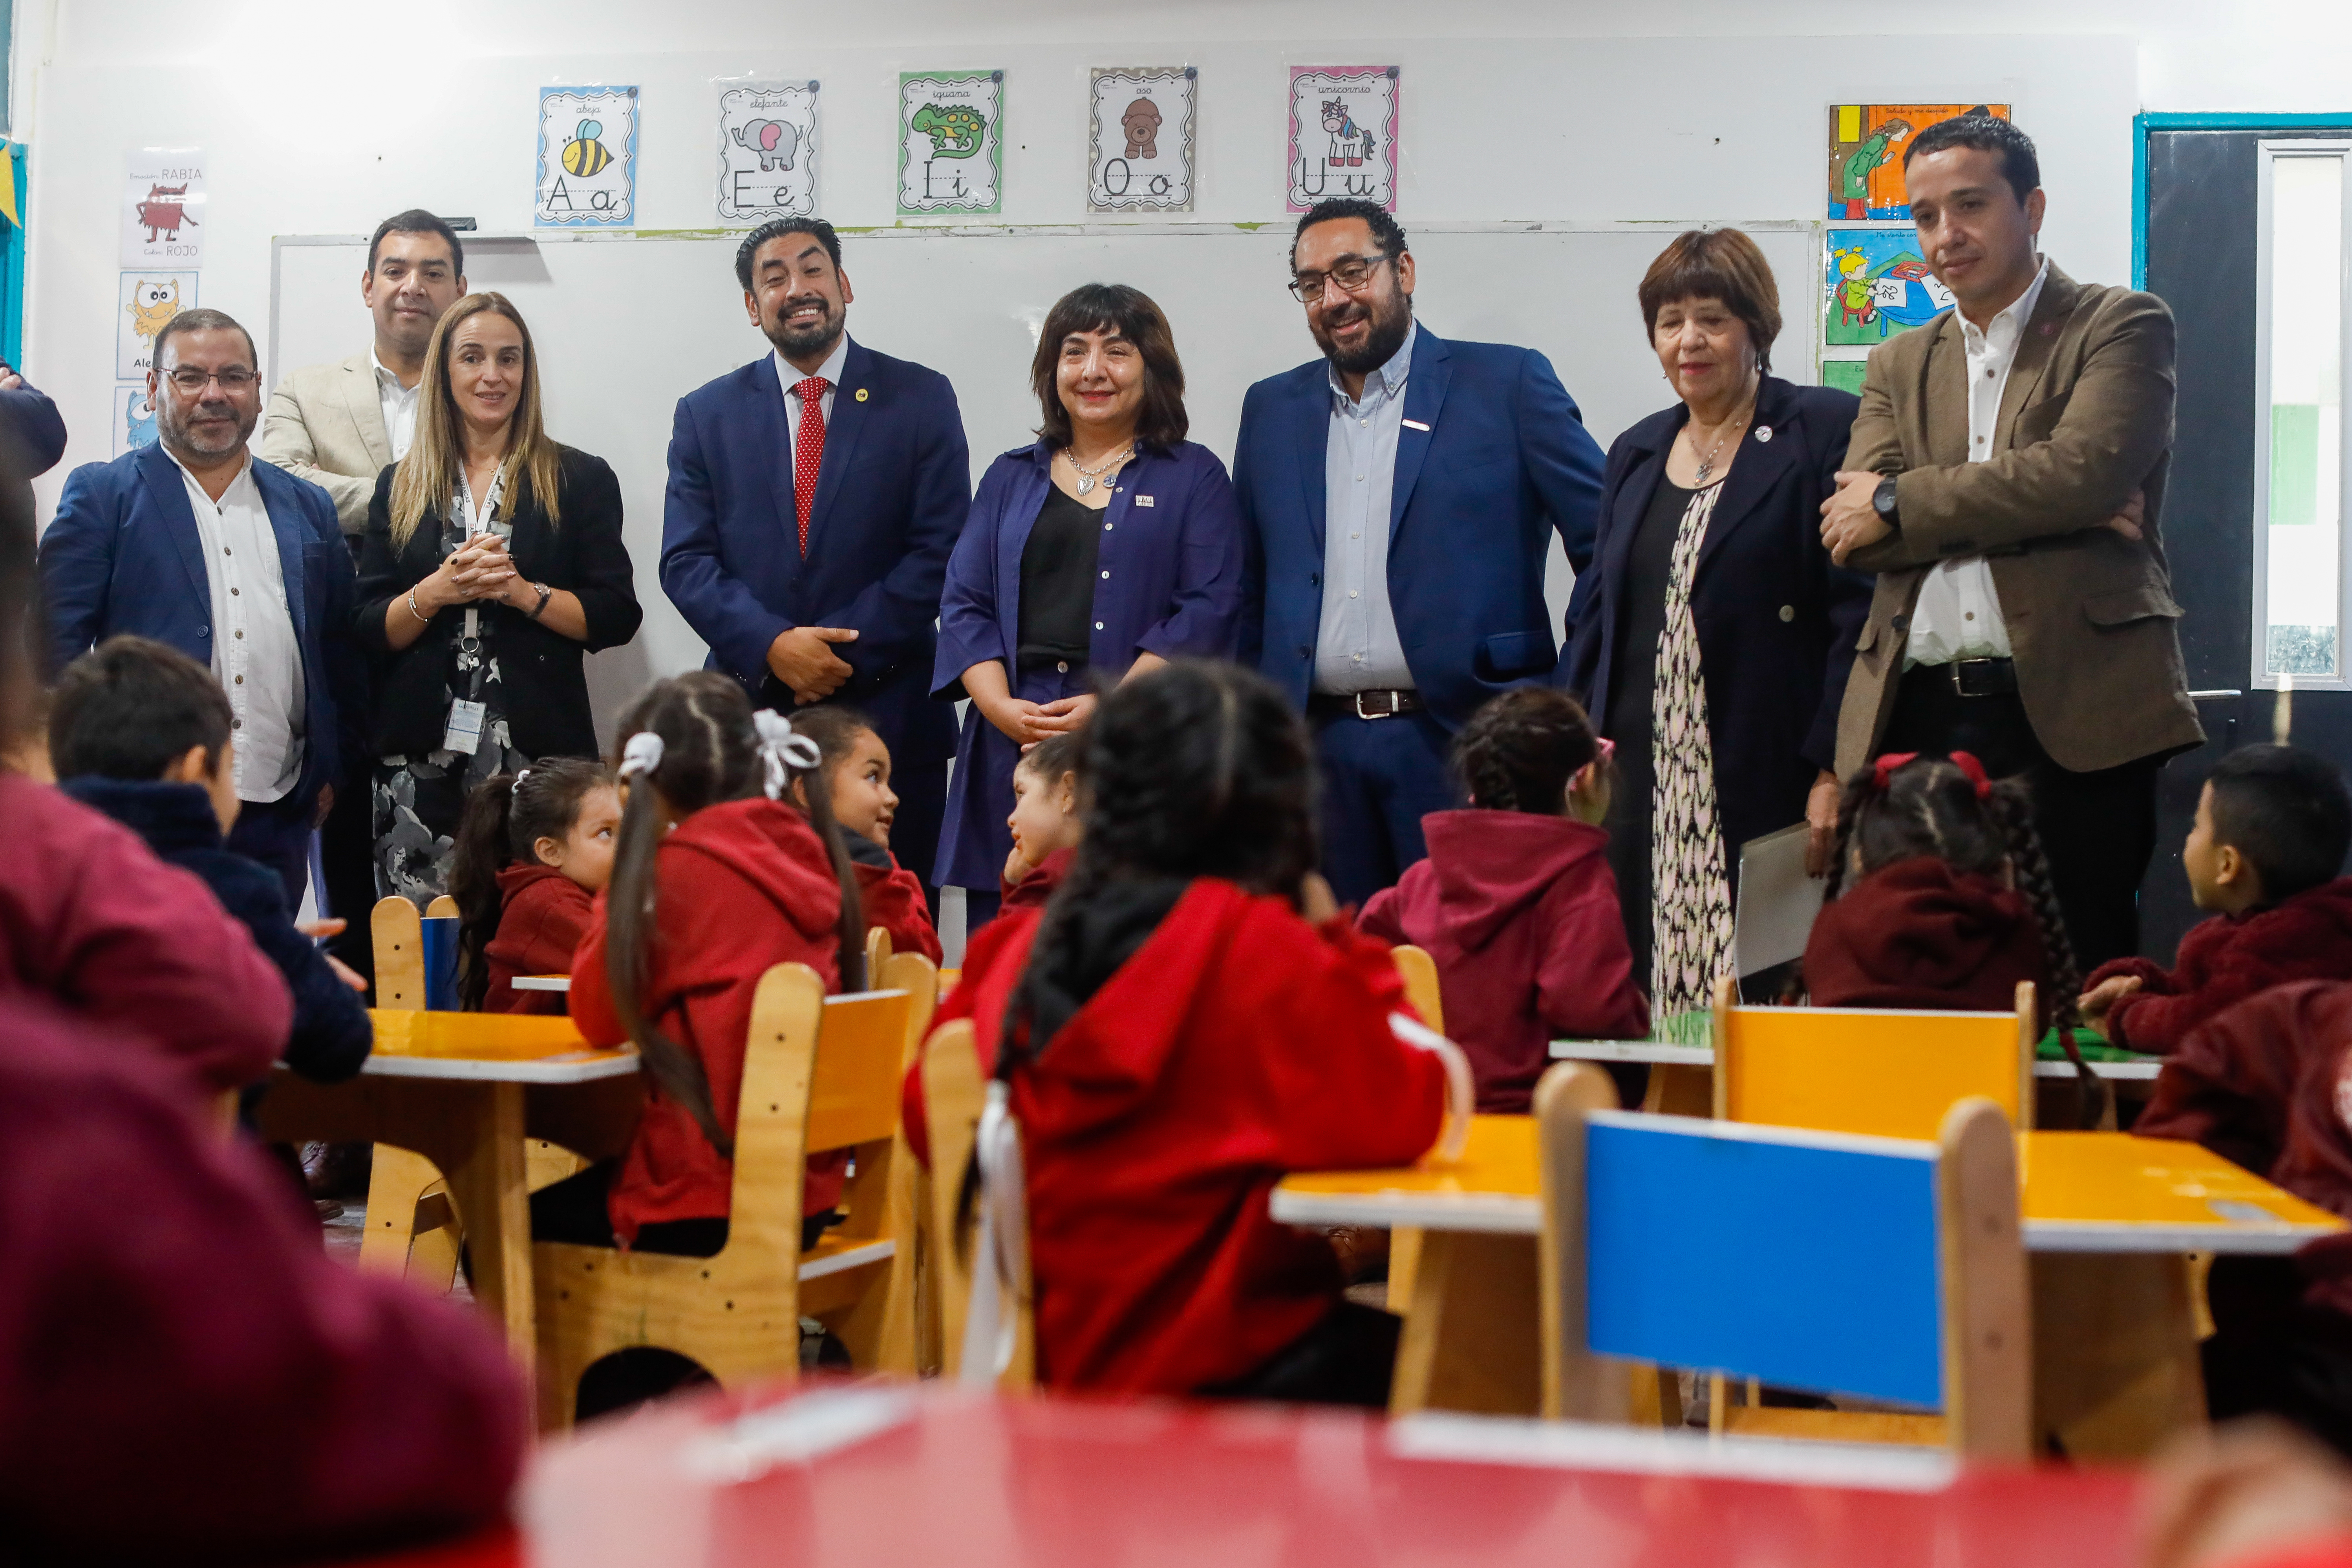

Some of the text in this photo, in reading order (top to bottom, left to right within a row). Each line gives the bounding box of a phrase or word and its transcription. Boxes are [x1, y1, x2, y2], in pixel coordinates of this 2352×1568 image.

[933, 90, 970, 101] iguana
[576, 104, 601, 116] abeja
[750, 98, 788, 111] elefante
[162, 168, 202, 180] RABIA
[924, 161, 969, 198] I i
[1104, 158, 1173, 196] O o
[1303, 158, 1375, 195] U u
[547, 175, 618, 210] A a
[735, 170, 794, 208] E e
[167, 245, 197, 256] ROJO
[134, 358, 151, 368] Ale
